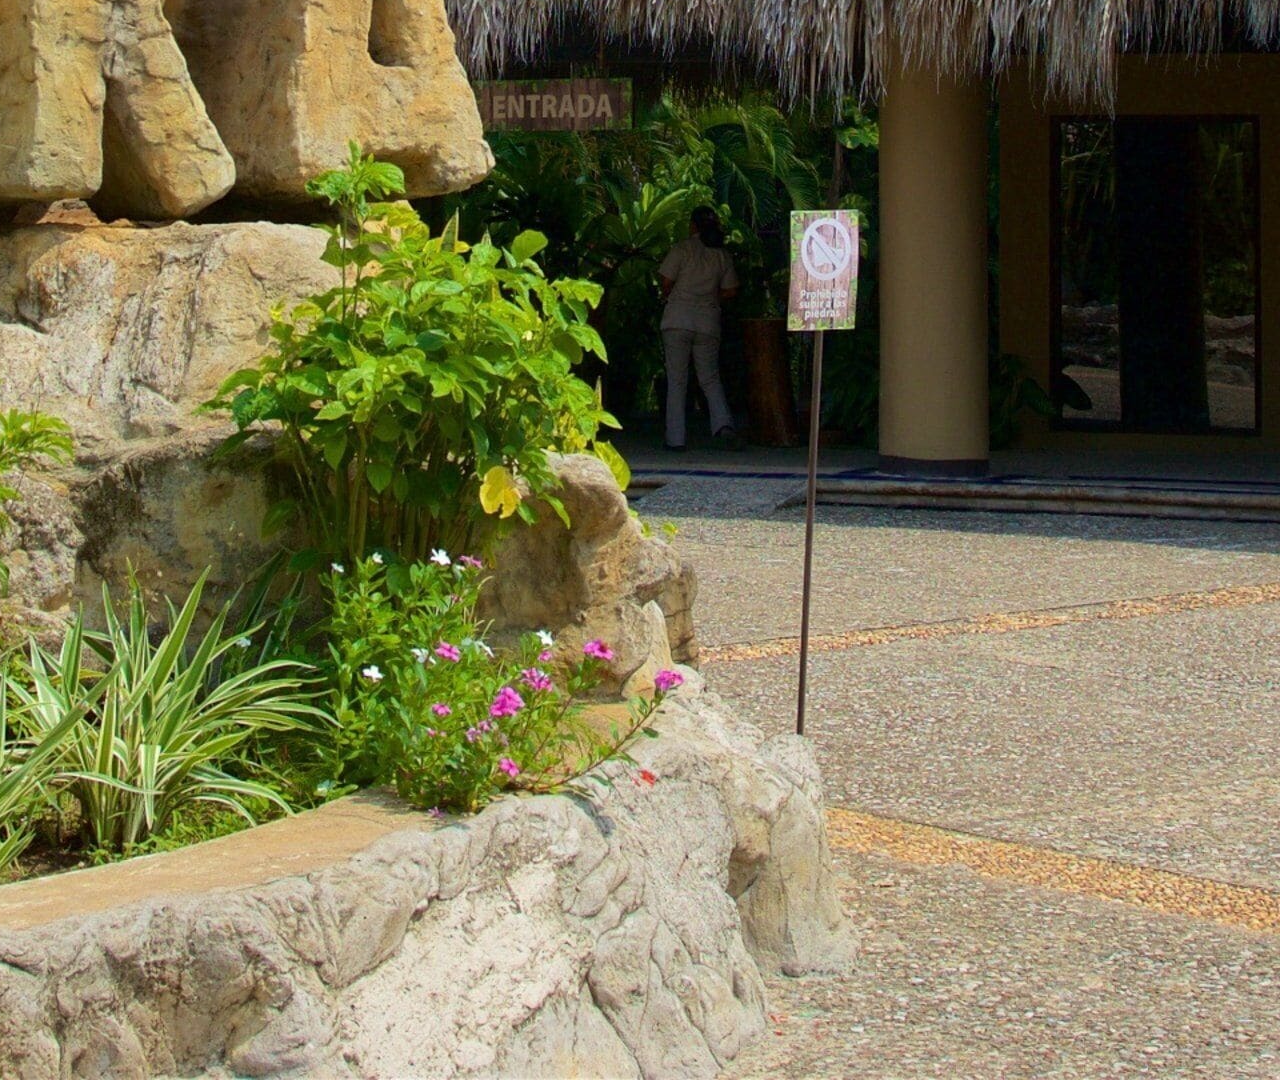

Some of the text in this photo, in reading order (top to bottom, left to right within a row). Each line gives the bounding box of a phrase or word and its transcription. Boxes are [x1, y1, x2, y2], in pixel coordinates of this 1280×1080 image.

[493, 94, 613, 119] ENTRADA
[800, 289, 847, 299] Prohibido
[800, 298, 823, 308] subir
[805, 308, 841, 321] piedras
